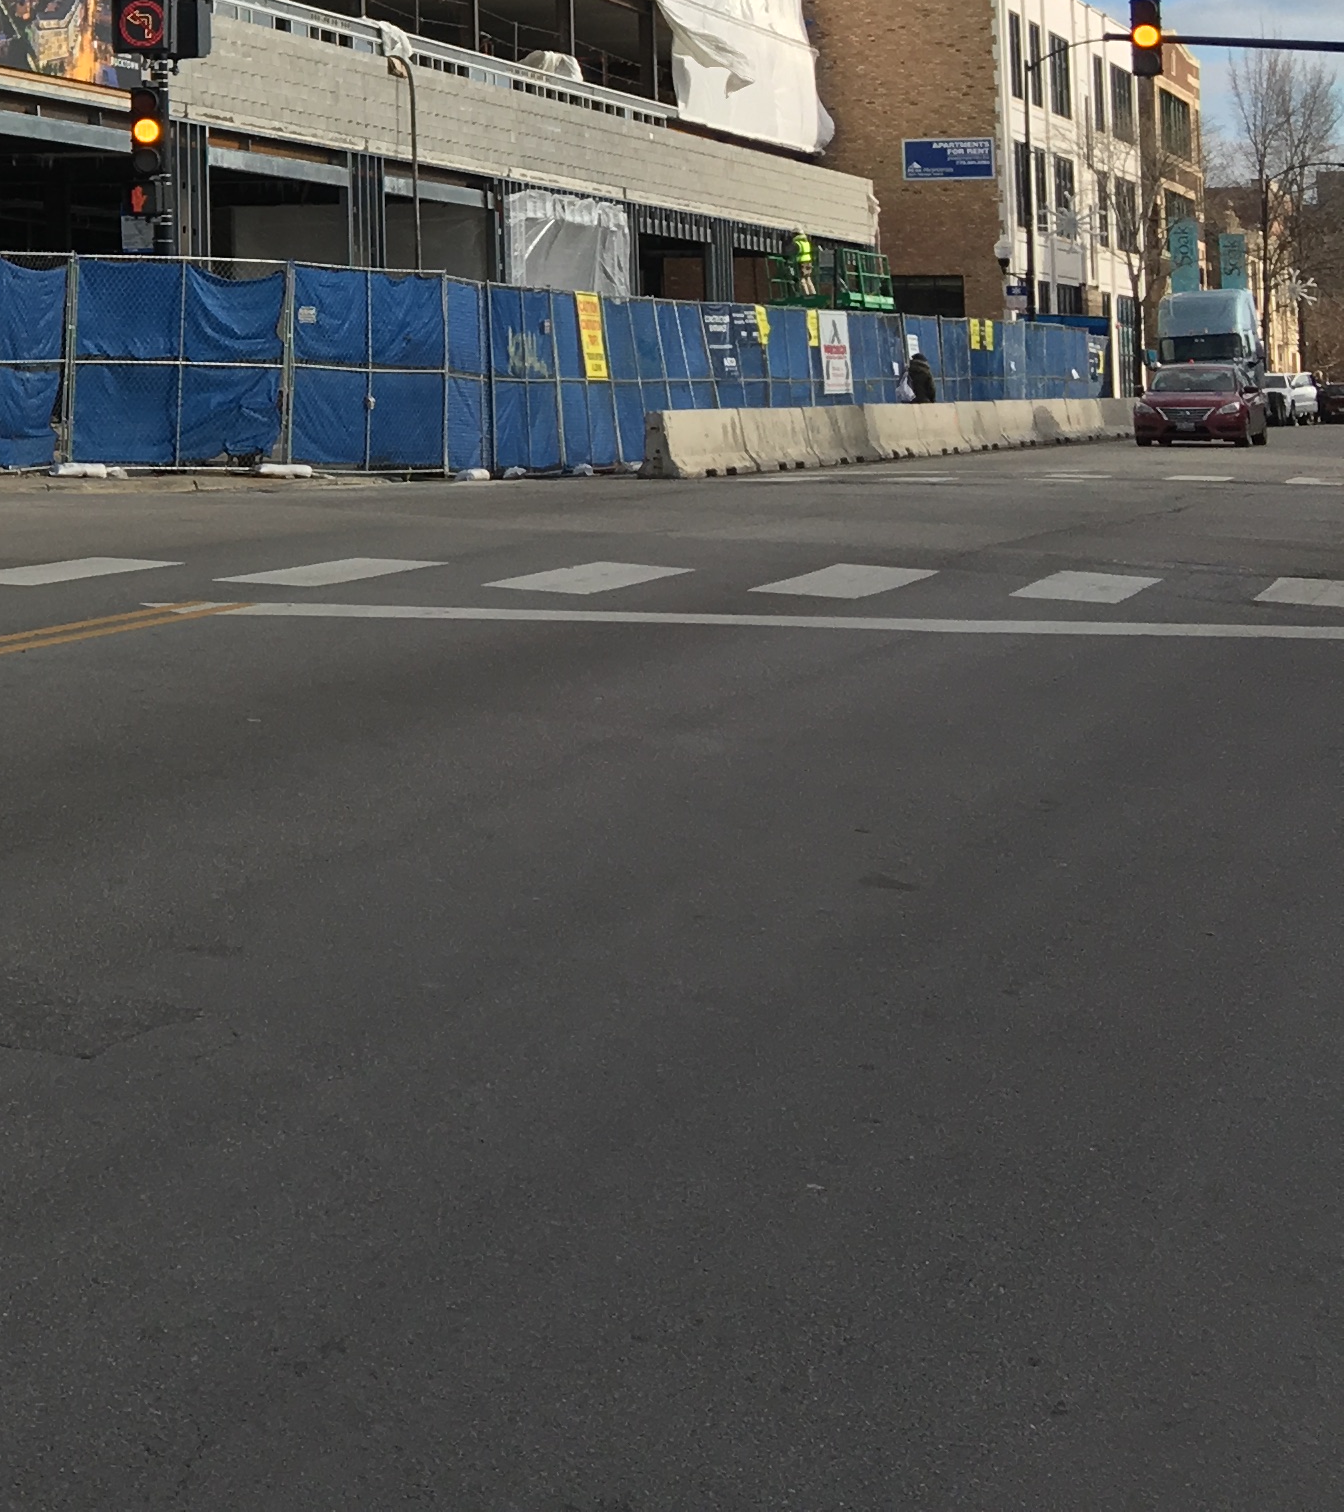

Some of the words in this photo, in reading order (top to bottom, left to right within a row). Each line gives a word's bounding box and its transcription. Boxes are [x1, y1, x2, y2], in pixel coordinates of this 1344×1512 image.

[932, 141, 990, 149] APARTMENTS
[967, 147, 989, 155] RENT
[1173, 226, 1193, 268] Soak
[1223, 241, 1241, 275] Soak
